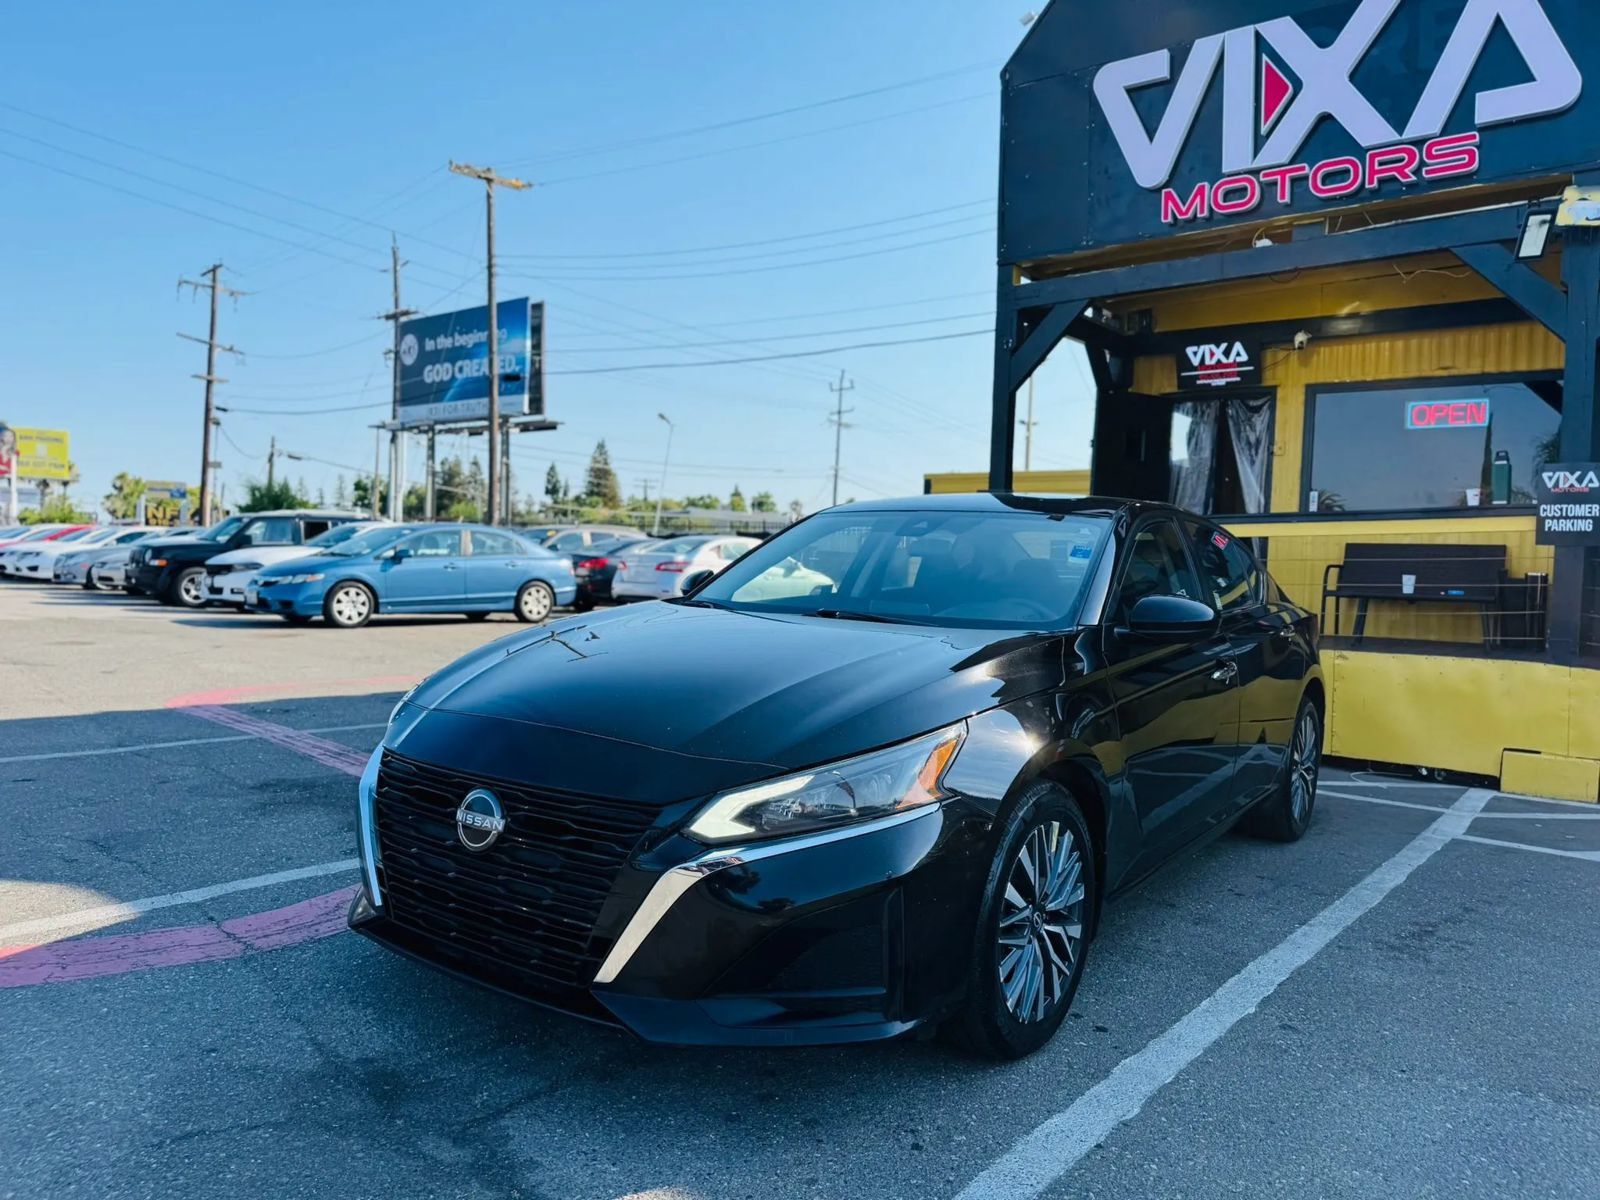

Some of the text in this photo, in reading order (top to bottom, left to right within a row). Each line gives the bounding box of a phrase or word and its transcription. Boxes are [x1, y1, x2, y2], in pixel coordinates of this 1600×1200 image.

[1093, 0, 1583, 191] VIXA
[1161, 131, 1480, 223] MOTORS
[425, 337, 436, 351] In
[436, 334, 453, 349] the
[1185, 341, 1248, 366] VIXA
[423, 355, 521, 384] GOD CREAED.
[1411, 402, 1486, 426] OPEN
[1541, 470, 1600, 488] VIXA
[1540, 503, 1600, 517] CUSTOMER
[1545, 518, 1594, 532] PARKING
[457, 808, 505, 832] NISSAN
